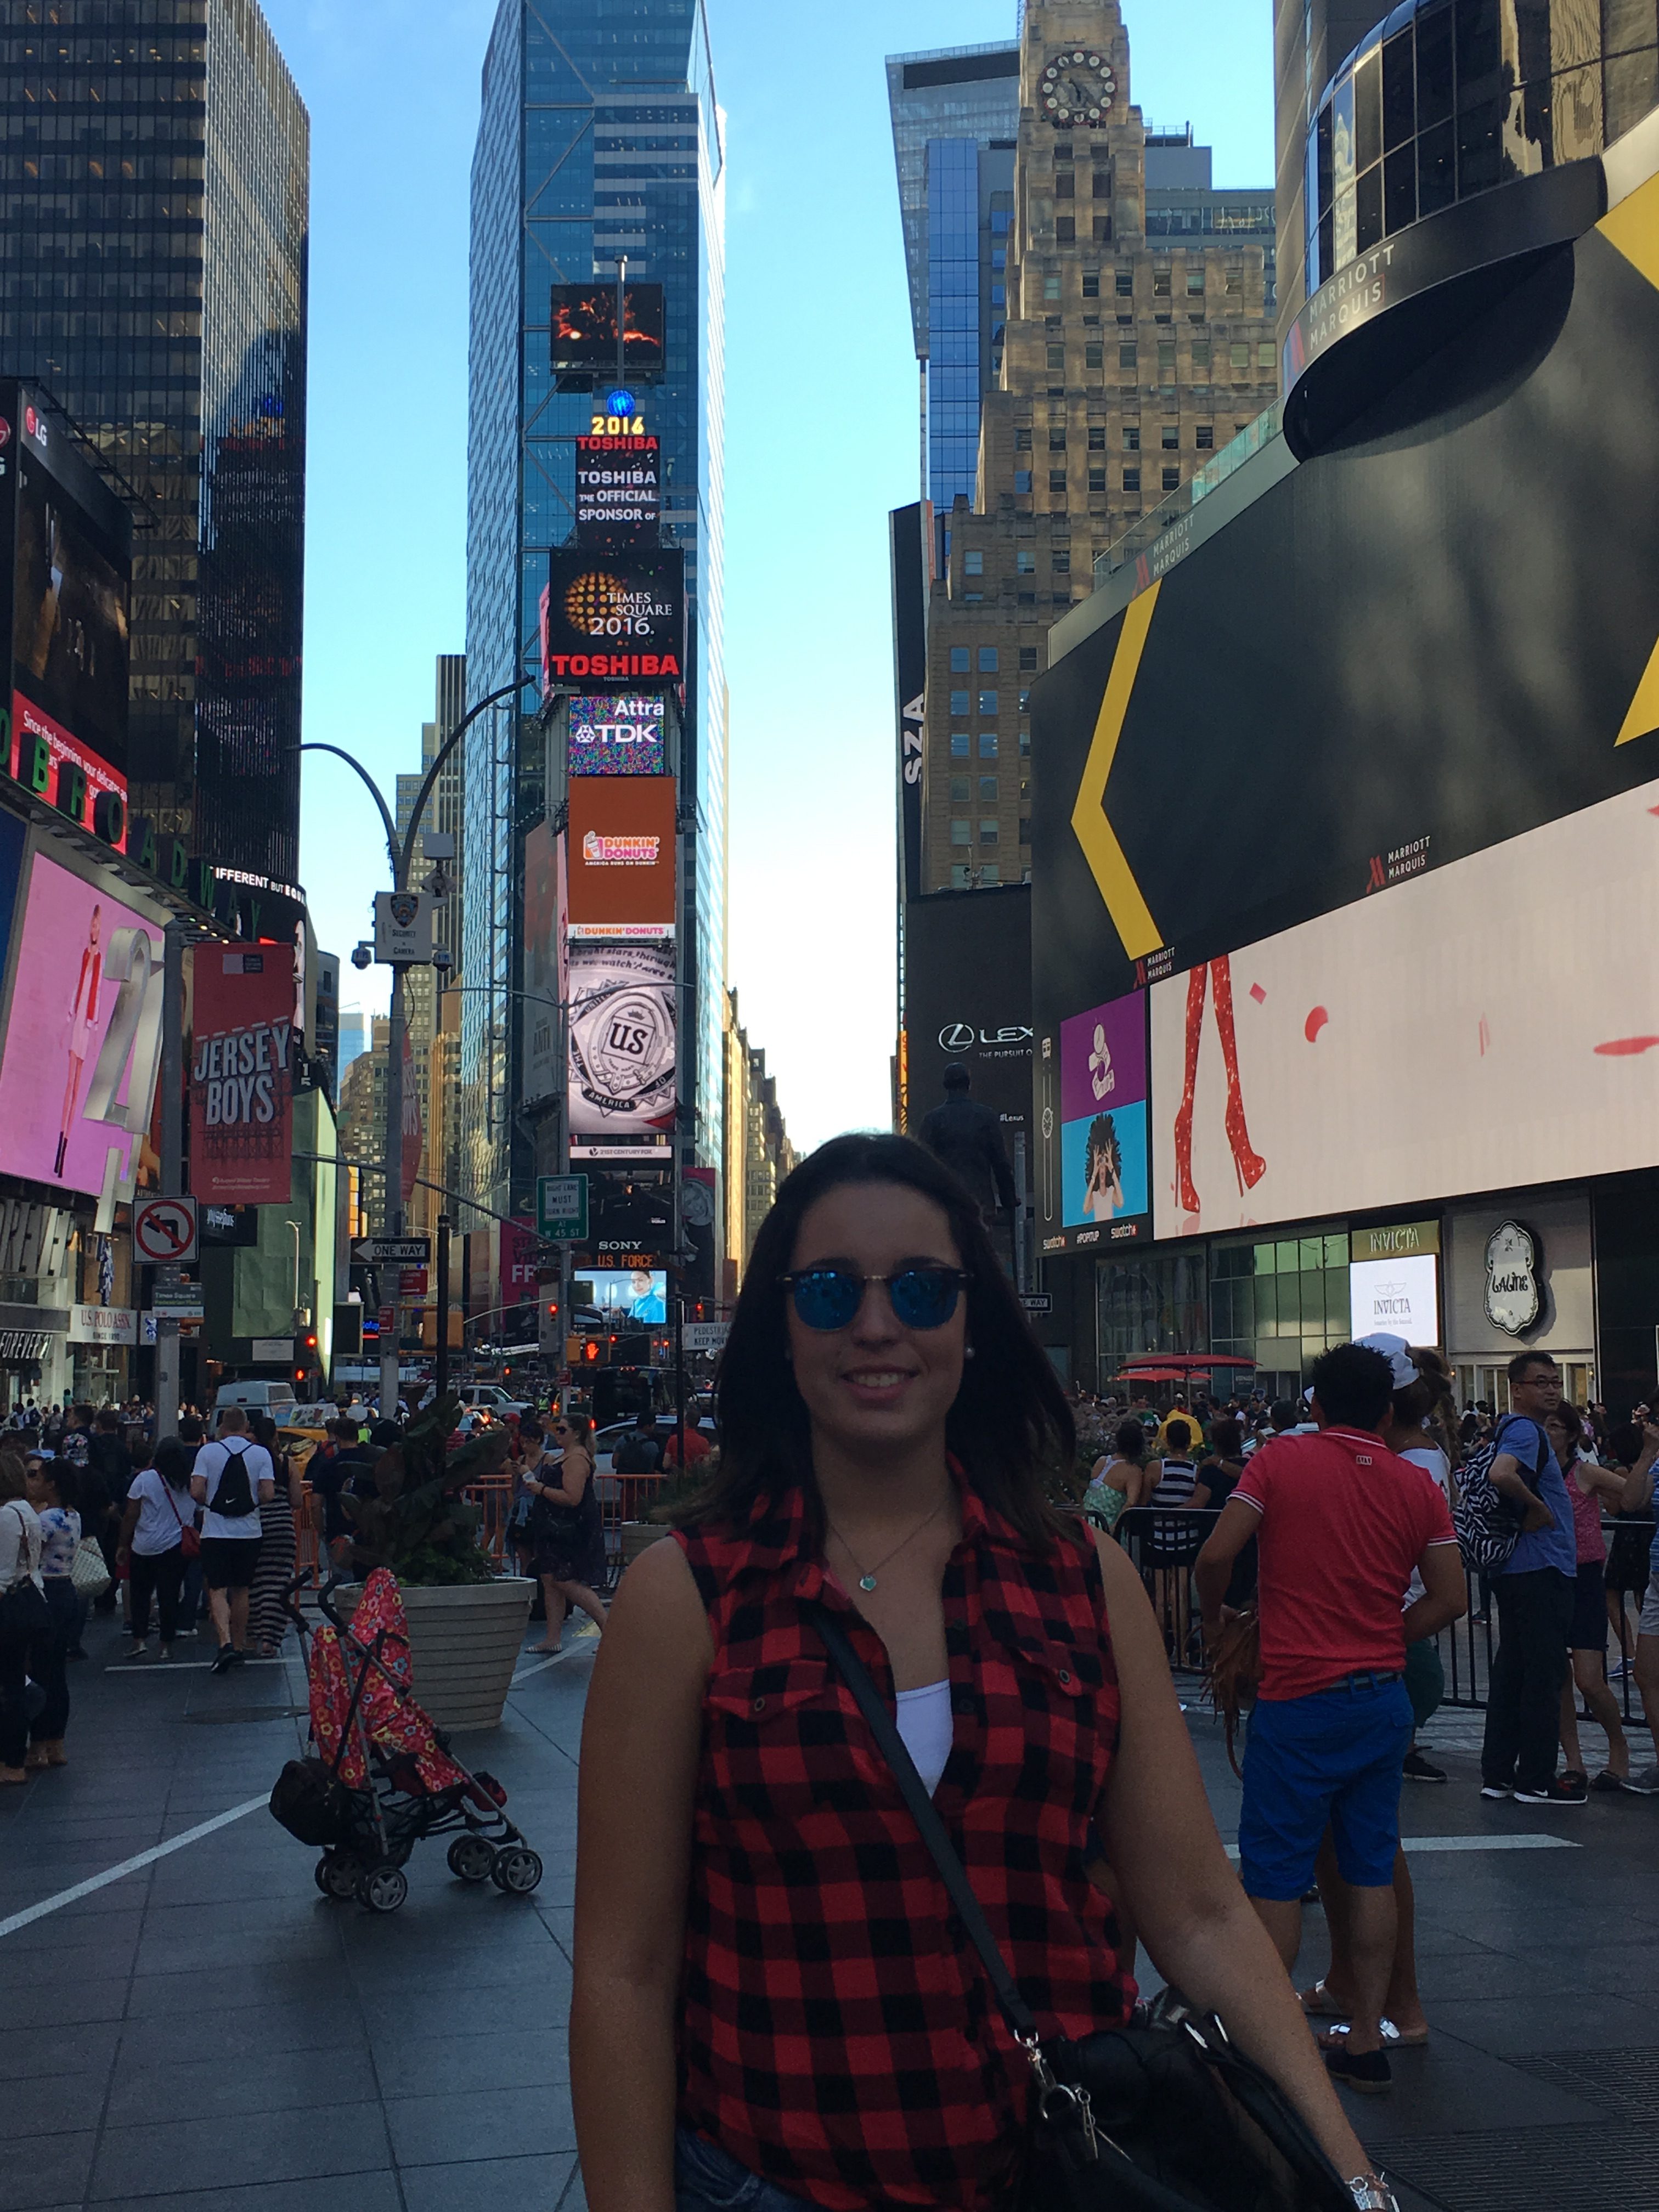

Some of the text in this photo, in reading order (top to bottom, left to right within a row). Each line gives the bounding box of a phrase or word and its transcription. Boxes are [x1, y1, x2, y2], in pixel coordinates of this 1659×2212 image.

[1310, 244, 1395, 323] MARRIOTT
[1310, 281, 1381, 351] MARQUIS
[35, 417, 47, 447] LG
[591, 416, 645, 435] 2016
[577, 436, 658, 450] TOSHIBA
[578, 470, 657, 484] TOSHIBA
[596, 490, 656, 502] OFFICIAL
[579, 509, 656, 521] SPONSOR OF
[1153, 513, 1194, 558] MARRIOTT
[1153, 538, 1189, 576] MARQUIS
[606, 592, 652, 603] TIMES
[616, 604, 673, 618] SQUARE
[552, 654, 680, 676] TOSHIBA
[614, 699, 664, 716] Attra
[594, 724, 658, 743] TDK
[24, 710, 41, 736] Since
[41, 725, 53, 746] the
[83, 760, 97, 778] your
[605, 838, 660, 848] DUNKIN'
[1387, 836, 1431, 864] MARRIOTT
[605, 848, 657, 858] DONUTS
[1389, 854, 1426, 879] MARQUIS
[209, 867, 269, 889] IFFERENT
[270, 881, 284, 894] BUT
[1147, 946, 1175, 967] MARRIOTT
[82, 926, 165, 1134] 21
[610, 1022, 648, 1054] US
[194, 1023, 290, 1082] JERSEY
[994, 1048, 1024, 1058] PURSUIT
[206, 1073, 275, 1126] BOYS
[588, 1091, 630, 1108] AMERICA
[552, 1195, 571, 1204] MUST
[554, 1228, 566, 1237] 45
[1110, 1225, 1132, 1240] swatch
[1369, 1227, 1420, 1254] INVICTA
[374, 1245, 422, 1256] ONE WAY
[599, 1241, 642, 1250] SONY
[621, 1254, 654, 1268] FORCE
[1374, 1298, 1411, 1315] INVICTA
[94, 1311, 112, 1328] POLO
[0, 1331, 42, 1359] FOREVER
[694, 1338, 709, 1346] KEEP
